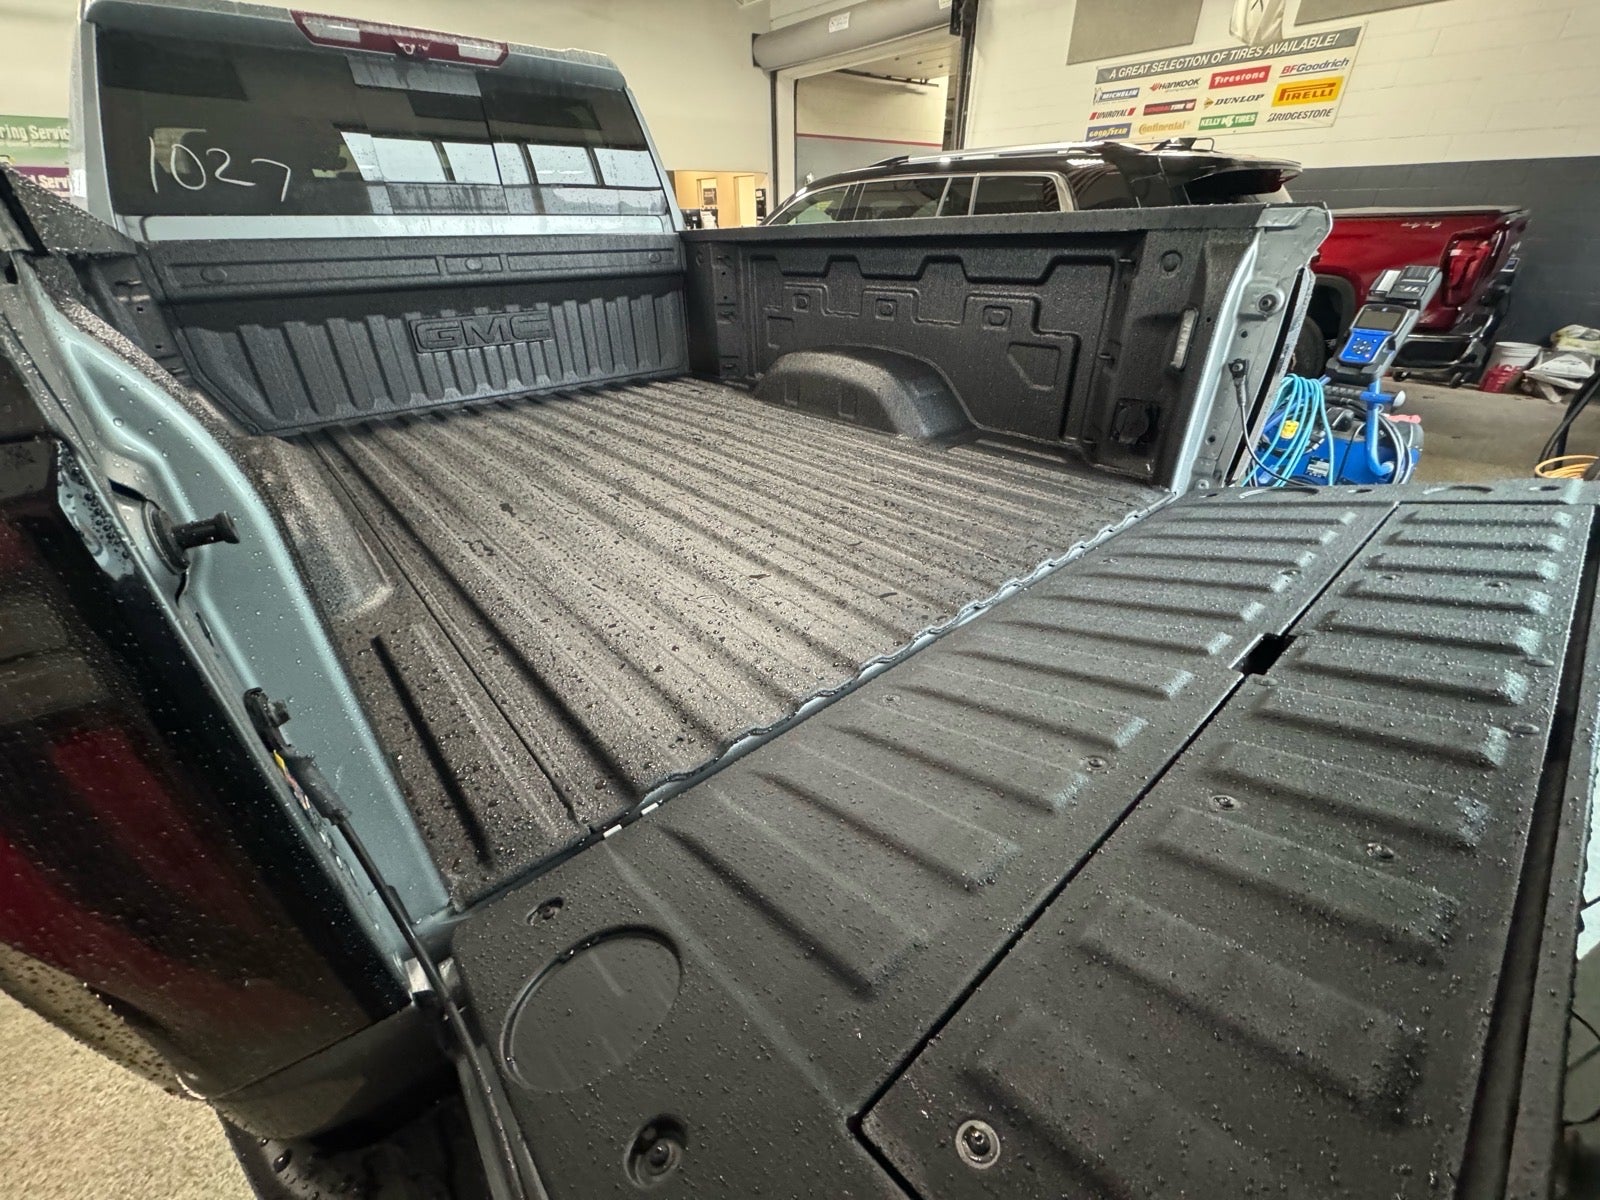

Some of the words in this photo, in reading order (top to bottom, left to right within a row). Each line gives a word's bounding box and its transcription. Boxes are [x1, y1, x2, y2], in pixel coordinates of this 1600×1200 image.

[1109, 70, 1117, 79] A
[1119, 64, 1150, 77] GREAT
[1151, 54, 1209, 73] SELECTION
[1210, 51, 1228, 64] OF
[1229, 46, 1263, 61] TIRES
[1264, 33, 1340, 56] AVAILABLE!
[1281, 57, 1349, 74] BFGoodrich
[1214, 71, 1266, 84] Firestone
[1102, 89, 1138, 99] MICHELIN
[1214, 93, 1265, 105] DUNLOP
[1278, 82, 1337, 102] PIRELLI
[1096, 110, 1127, 119] UNIROYAL
[1200, 116, 1221, 127] KELLY
[1234, 113, 1256, 124] TIRES
[1267, 107, 1334, 122] BRIDGESTONE
[1138, 122, 1185, 135] Continental
[149, 136, 291, 202] 1027
[415, 312, 550, 350] GMC
